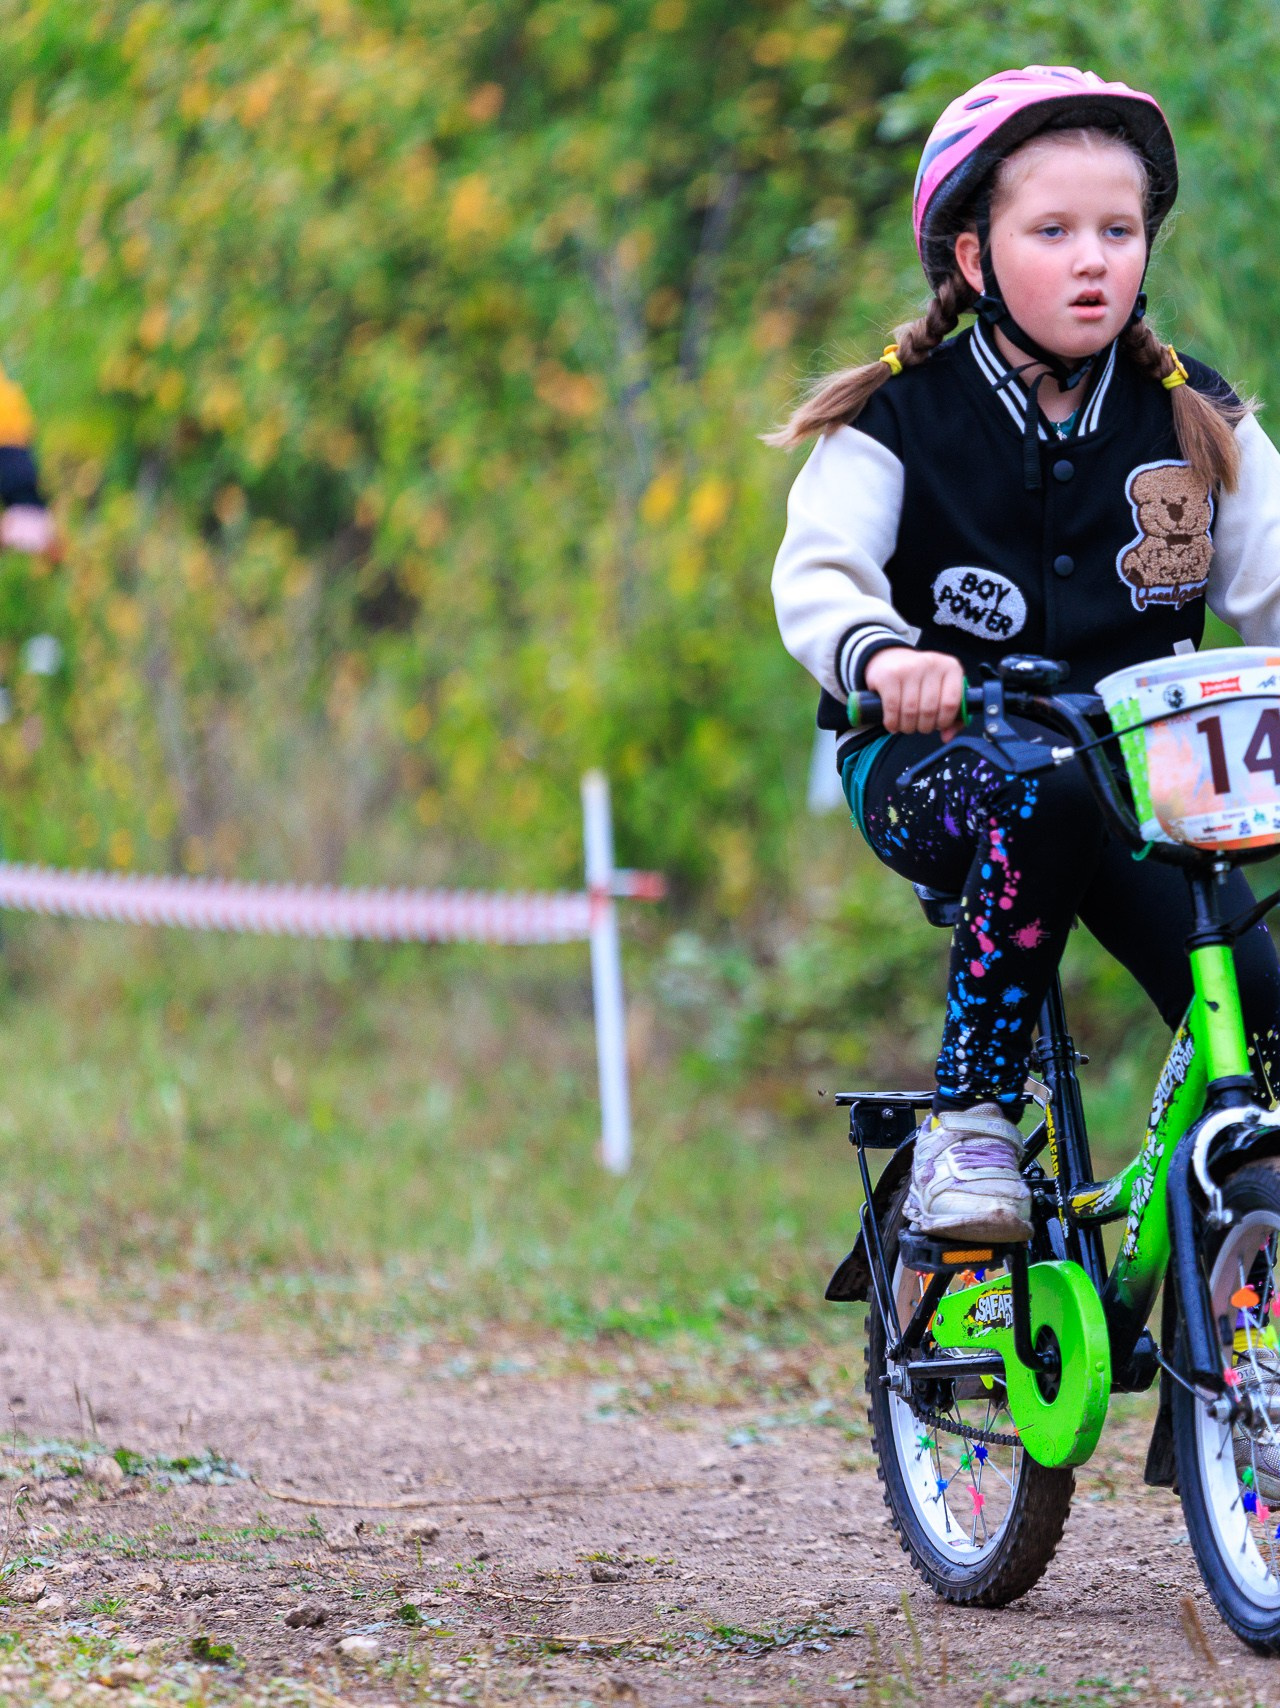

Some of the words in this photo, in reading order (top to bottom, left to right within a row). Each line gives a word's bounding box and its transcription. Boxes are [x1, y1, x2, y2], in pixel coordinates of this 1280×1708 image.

[939, 584, 1014, 637] POWER
[960, 572, 1012, 613] BOY
[975, 1293, 1014, 1323] SAFAR
